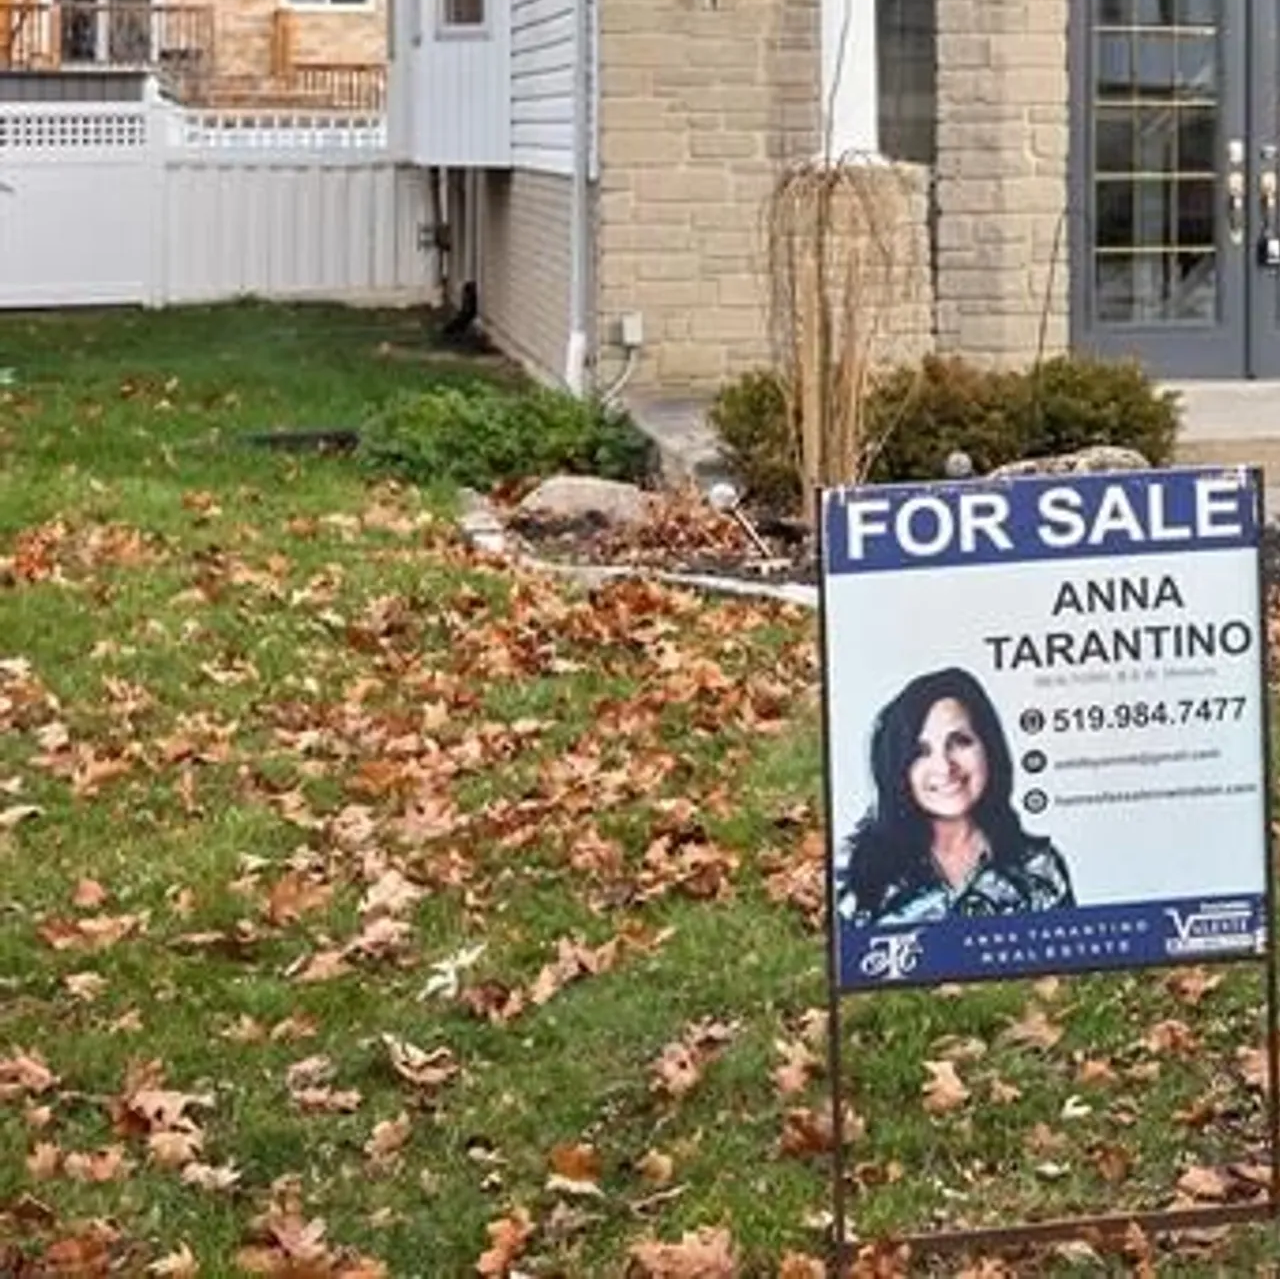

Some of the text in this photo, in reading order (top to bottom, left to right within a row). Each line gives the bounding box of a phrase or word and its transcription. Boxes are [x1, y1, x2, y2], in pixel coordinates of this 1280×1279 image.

[846, 479, 1242, 560] FOR SALE
[1051, 575, 1185, 617] ANNA
[984, 621, 1252, 671] TARANTINO
[1053, 697, 1247, 733] 519.984.7477
